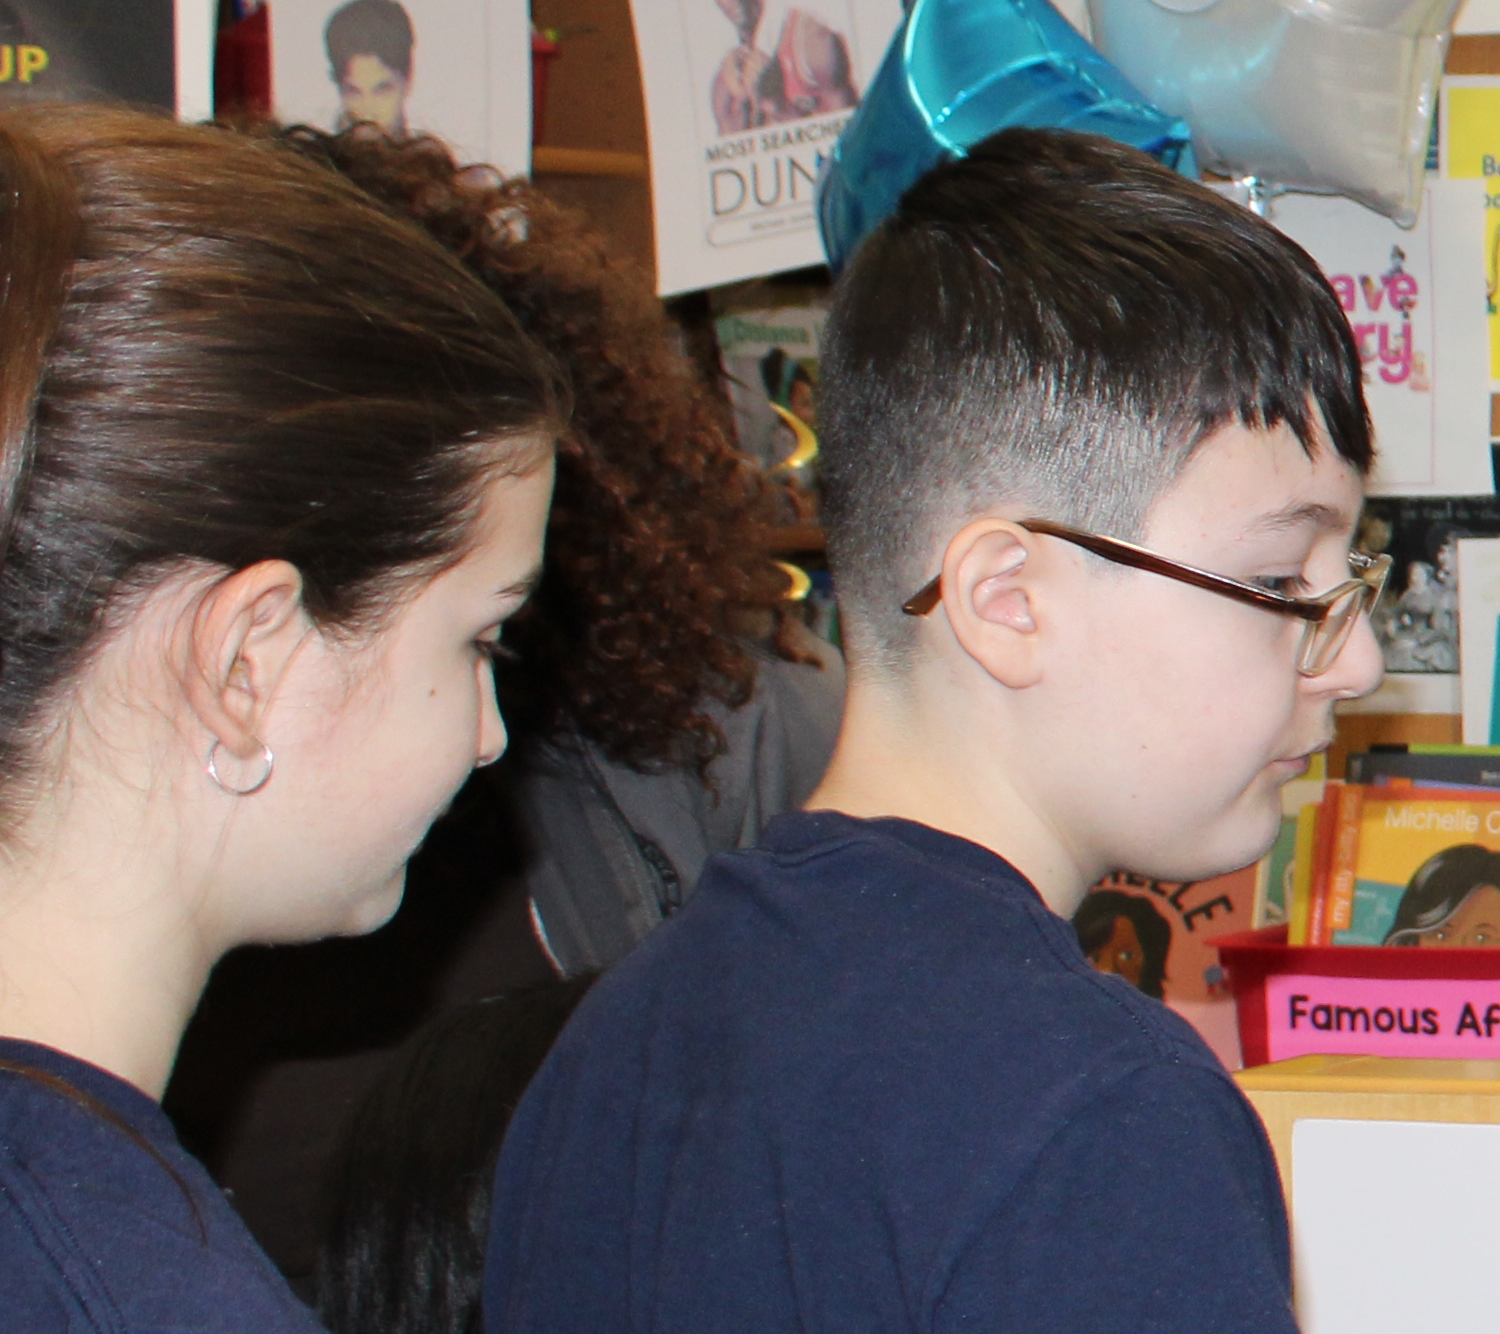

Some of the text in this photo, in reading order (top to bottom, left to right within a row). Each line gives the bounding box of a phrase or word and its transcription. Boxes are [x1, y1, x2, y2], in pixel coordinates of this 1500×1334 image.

[705, 139, 757, 163] MOST
[710, 155, 818, 216] DUN
[1329, 271, 1419, 313] ave
[1353, 322, 1413, 384] ry
[1385, 807, 1479, 833] Michelle
[1289, 995, 1438, 1036] Famous
